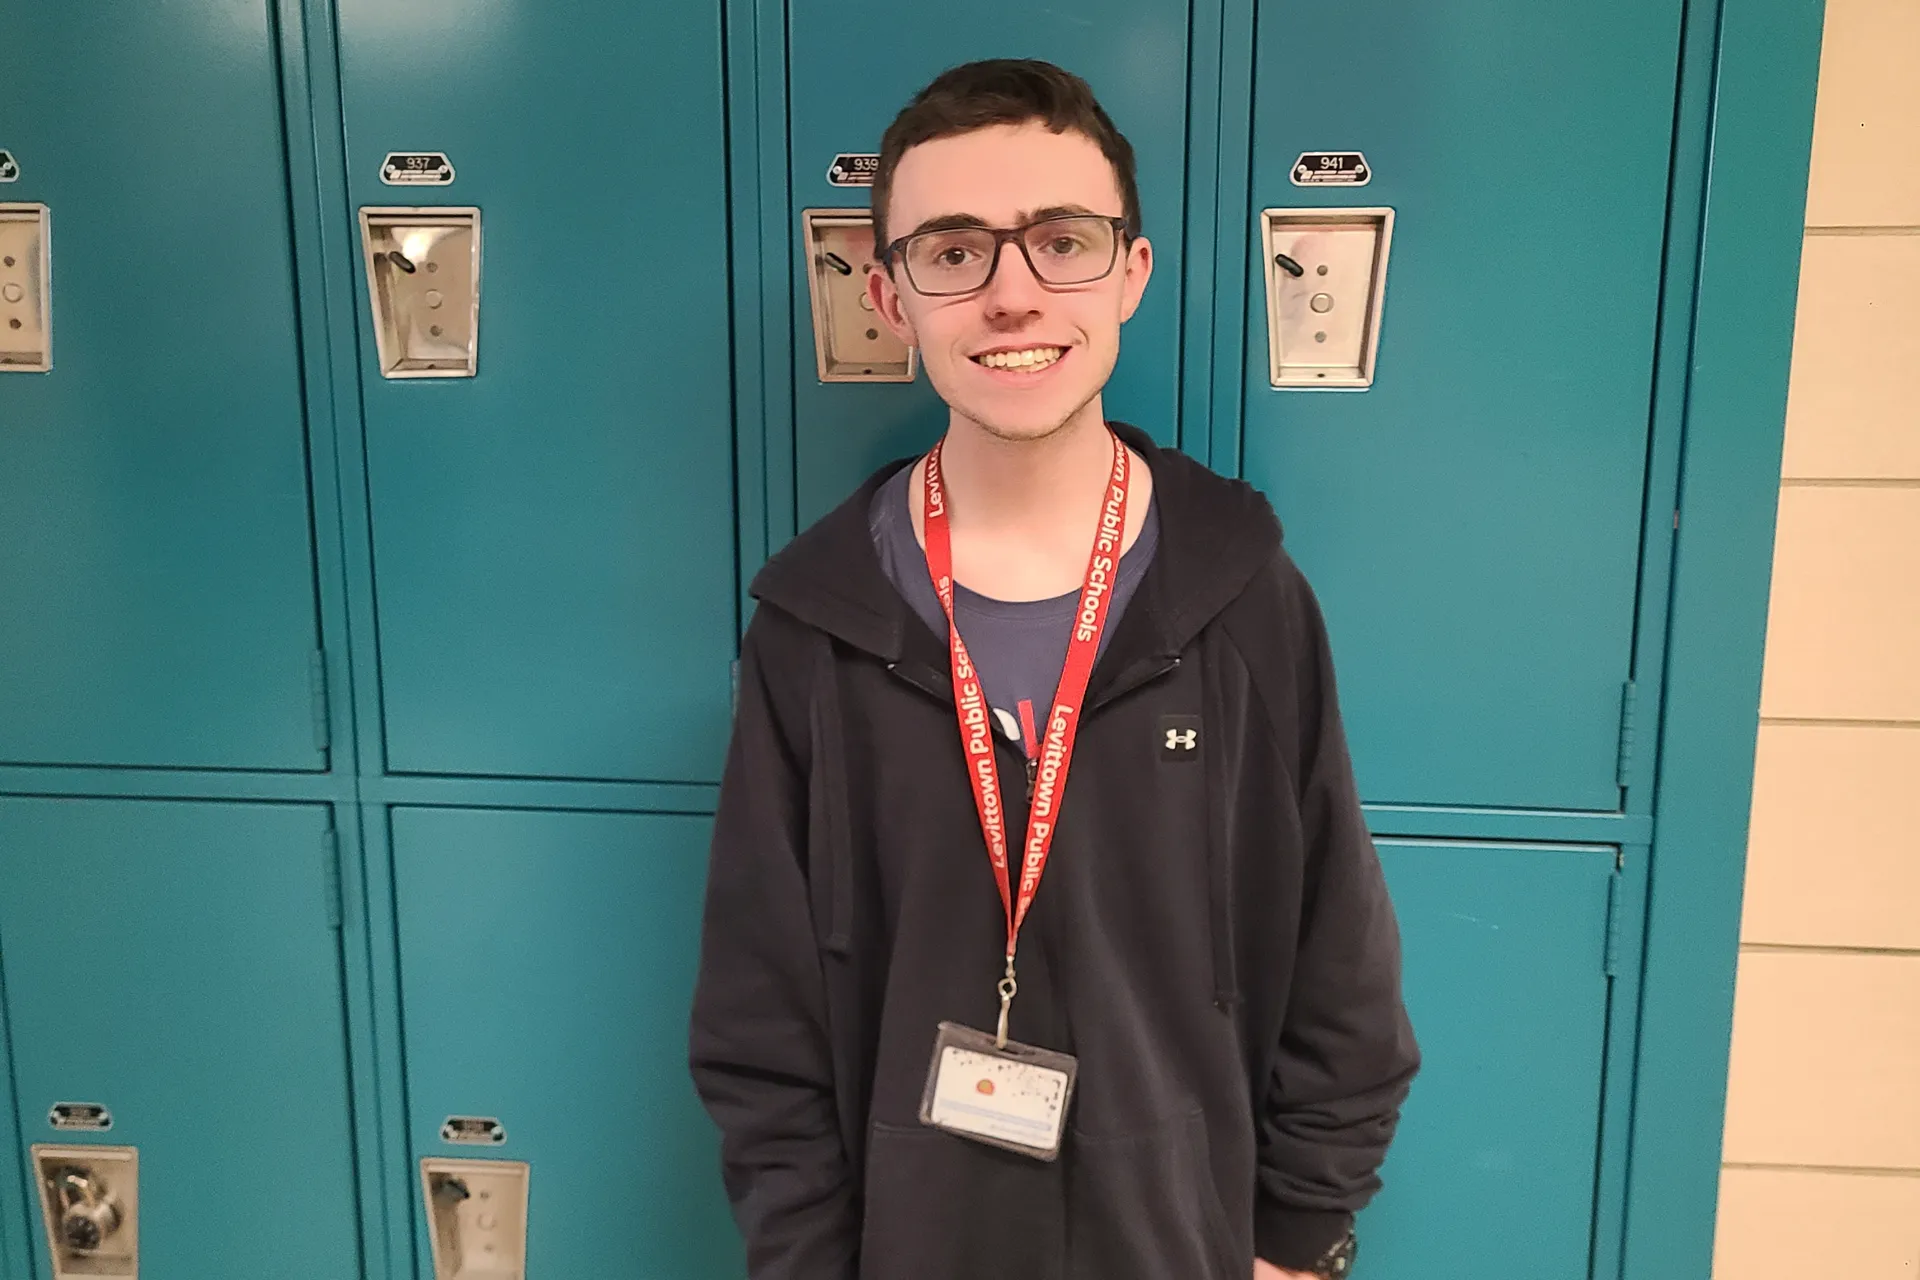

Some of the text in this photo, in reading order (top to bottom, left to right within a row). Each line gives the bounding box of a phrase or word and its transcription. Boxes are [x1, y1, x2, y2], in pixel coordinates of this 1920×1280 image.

[406, 157, 431, 169] 937
[854, 158, 879, 170] 939
[1320, 156, 1344, 169] 941
[1098, 485, 1125, 552] Public
[1076, 556, 1112, 642] Schools
[960, 683, 989, 755] Public
[975, 757, 1006, 869] Levittown
[1023, 704, 1074, 892] Levittown Public
